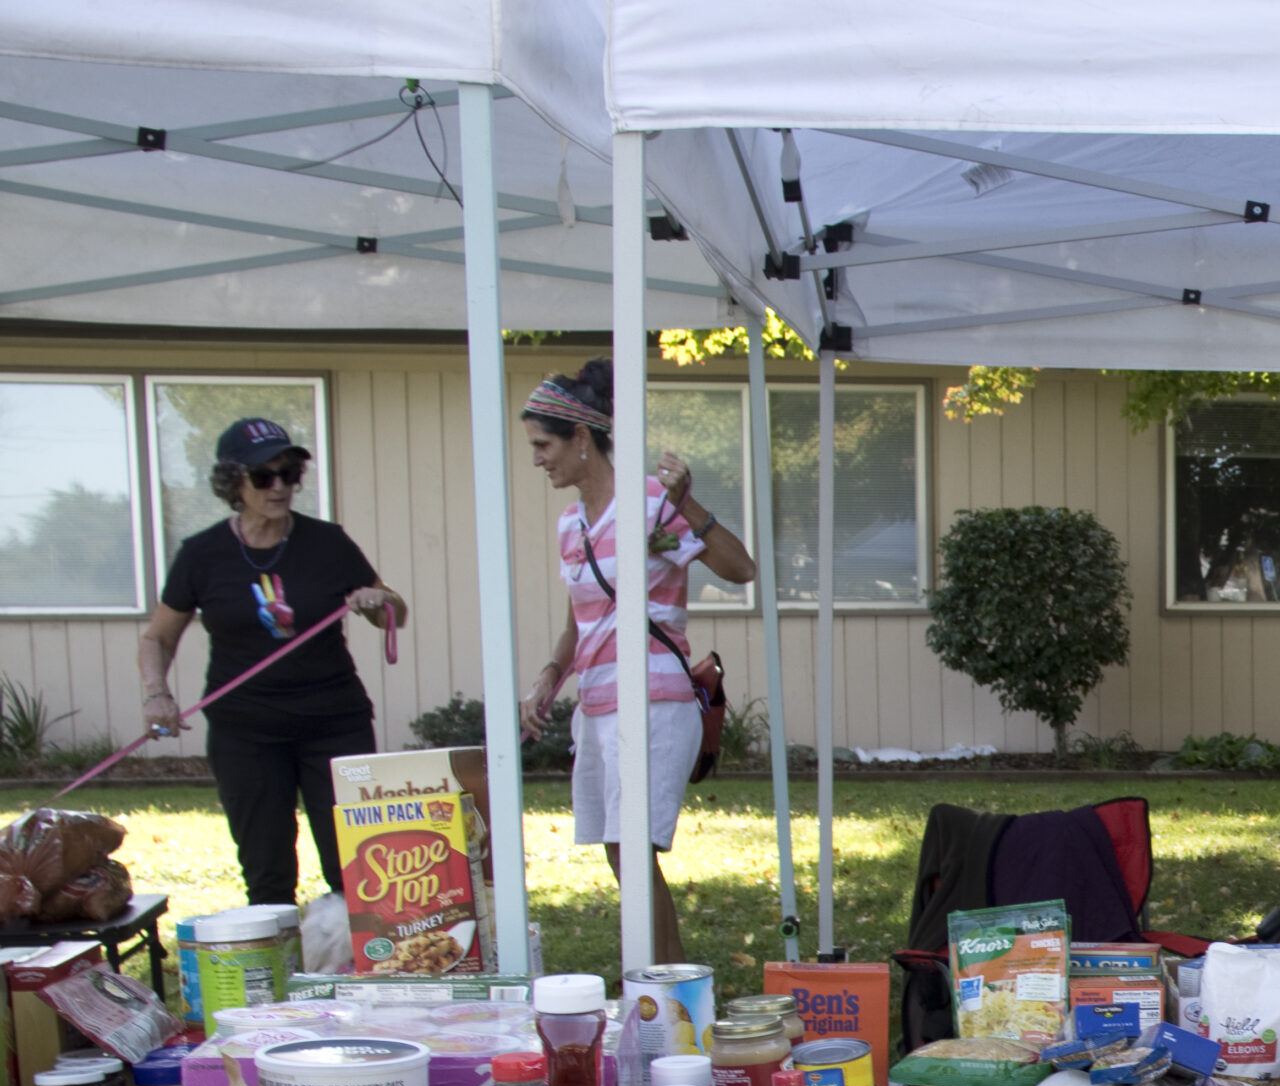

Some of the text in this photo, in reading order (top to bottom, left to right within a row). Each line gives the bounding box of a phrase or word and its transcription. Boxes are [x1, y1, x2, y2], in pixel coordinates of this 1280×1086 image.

[338, 764, 371, 777] Great
[342, 800, 426, 828] TWIN PACK
[356, 839, 450, 902] Stove
[387, 872, 441, 914] Top
[396, 912, 445, 939] TURKEY
[958, 938, 1013, 956] Knorr
[792, 987, 860, 1016] Ben's
[800, 1016, 860, 1036] riginal
[1227, 1045, 1267, 1055] ELBOWS
